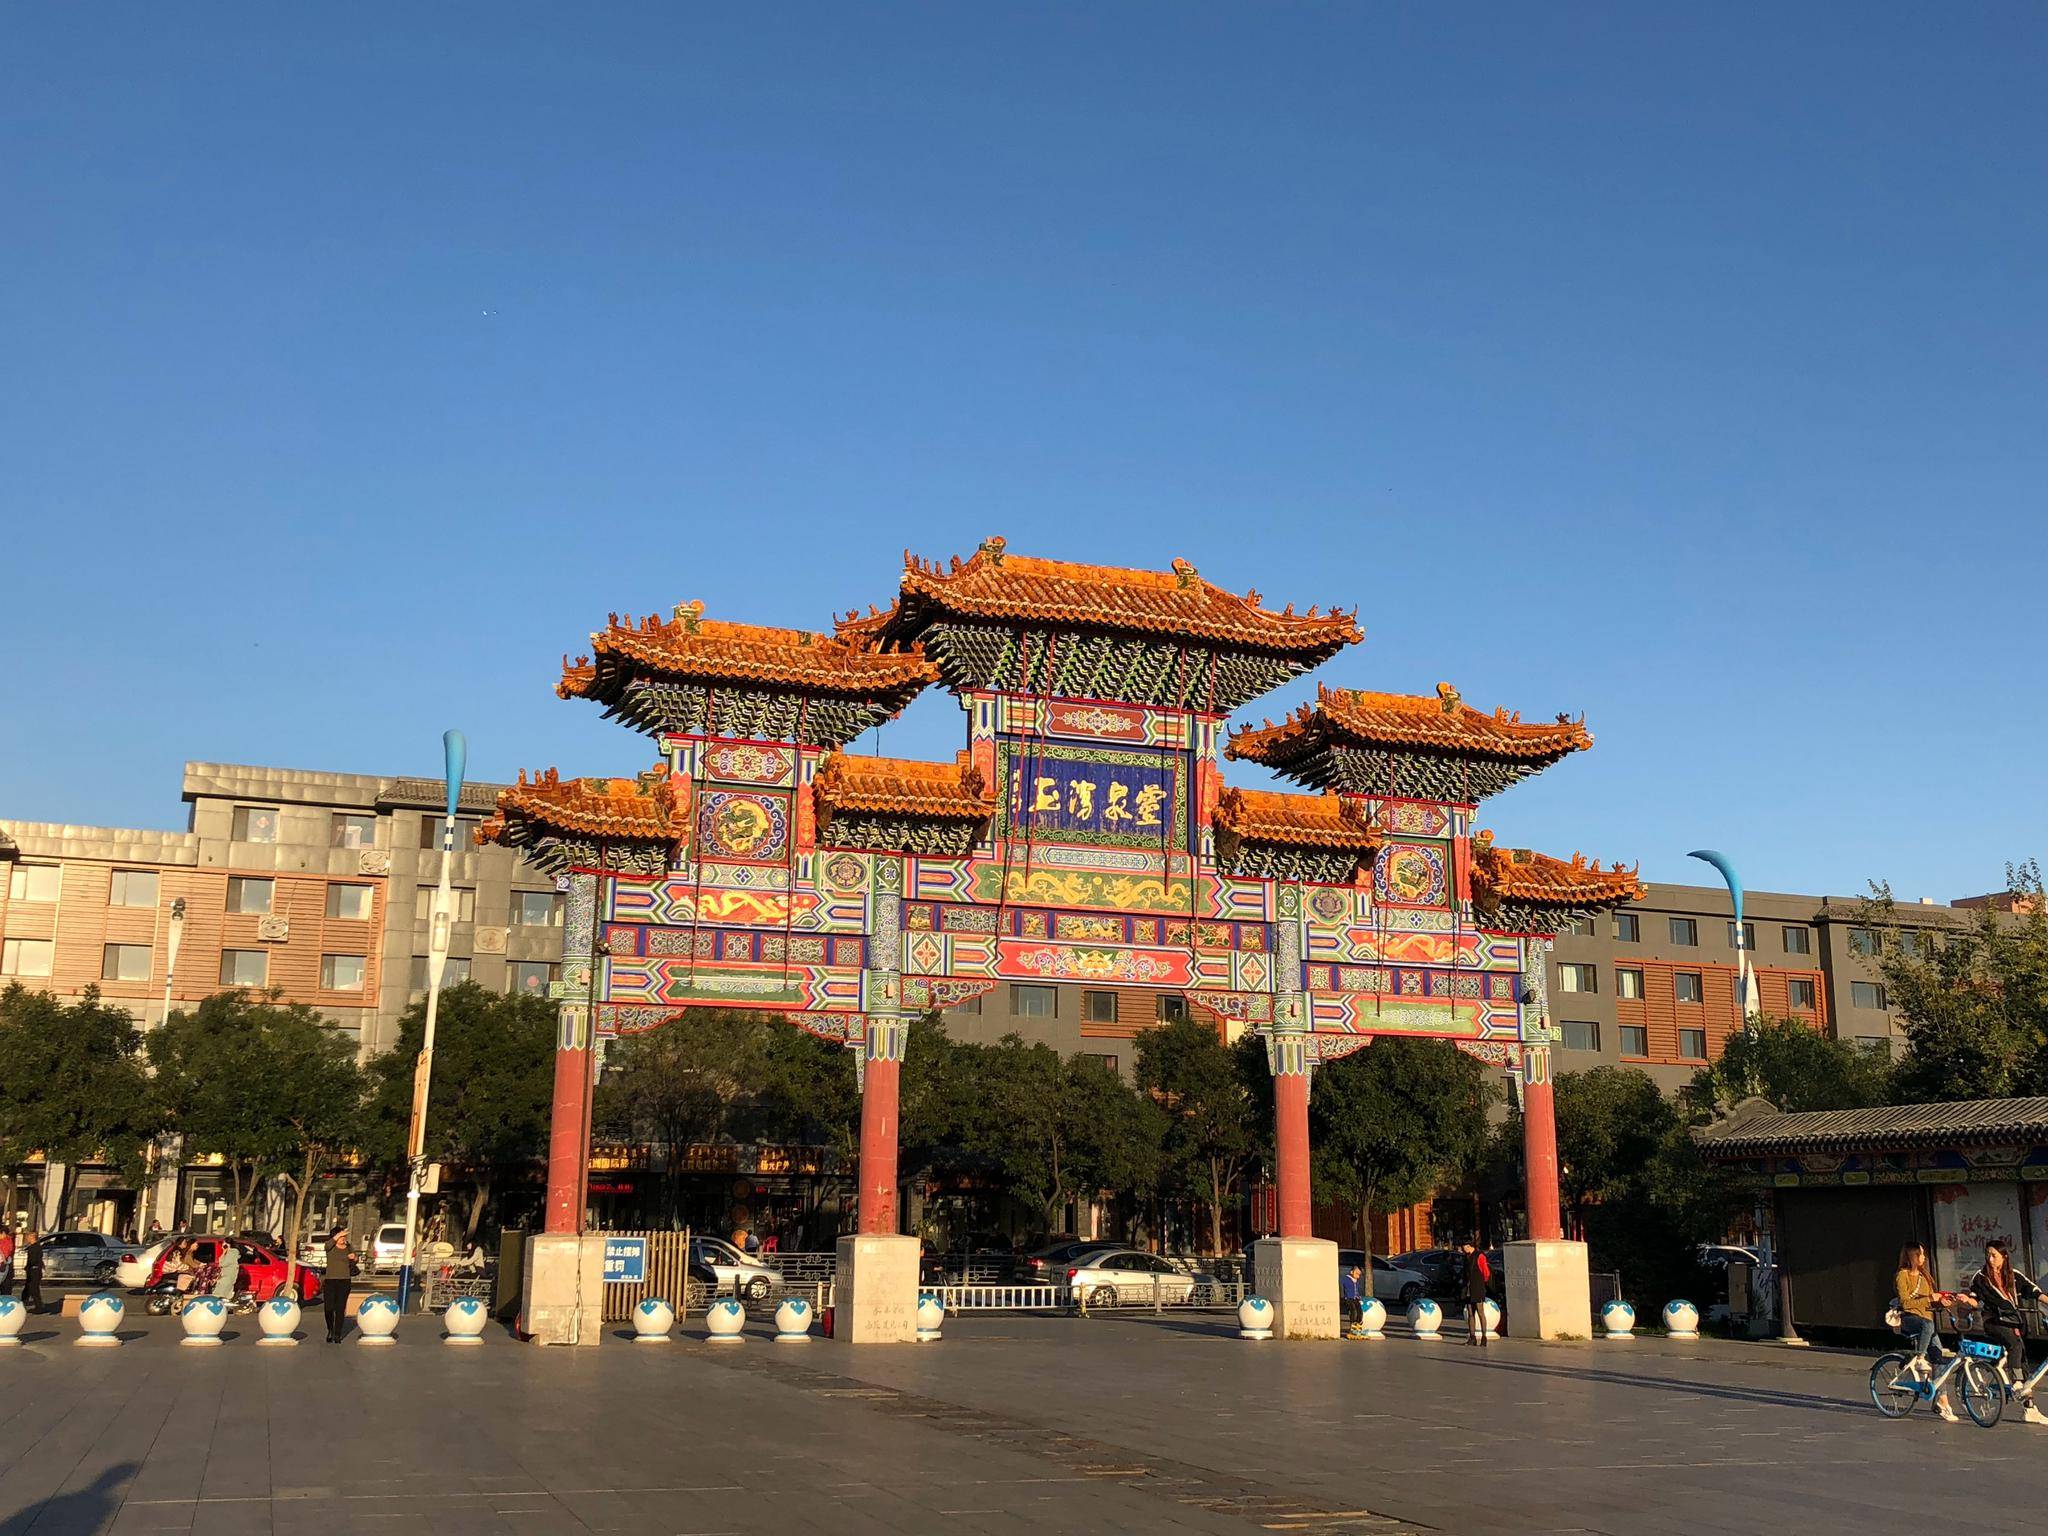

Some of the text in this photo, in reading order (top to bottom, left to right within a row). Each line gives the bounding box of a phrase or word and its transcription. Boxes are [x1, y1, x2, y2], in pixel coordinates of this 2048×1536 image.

[1961, 1214, 2002, 1235] 社会主义
[1947, 1232, 2017, 1253] 核心价观
